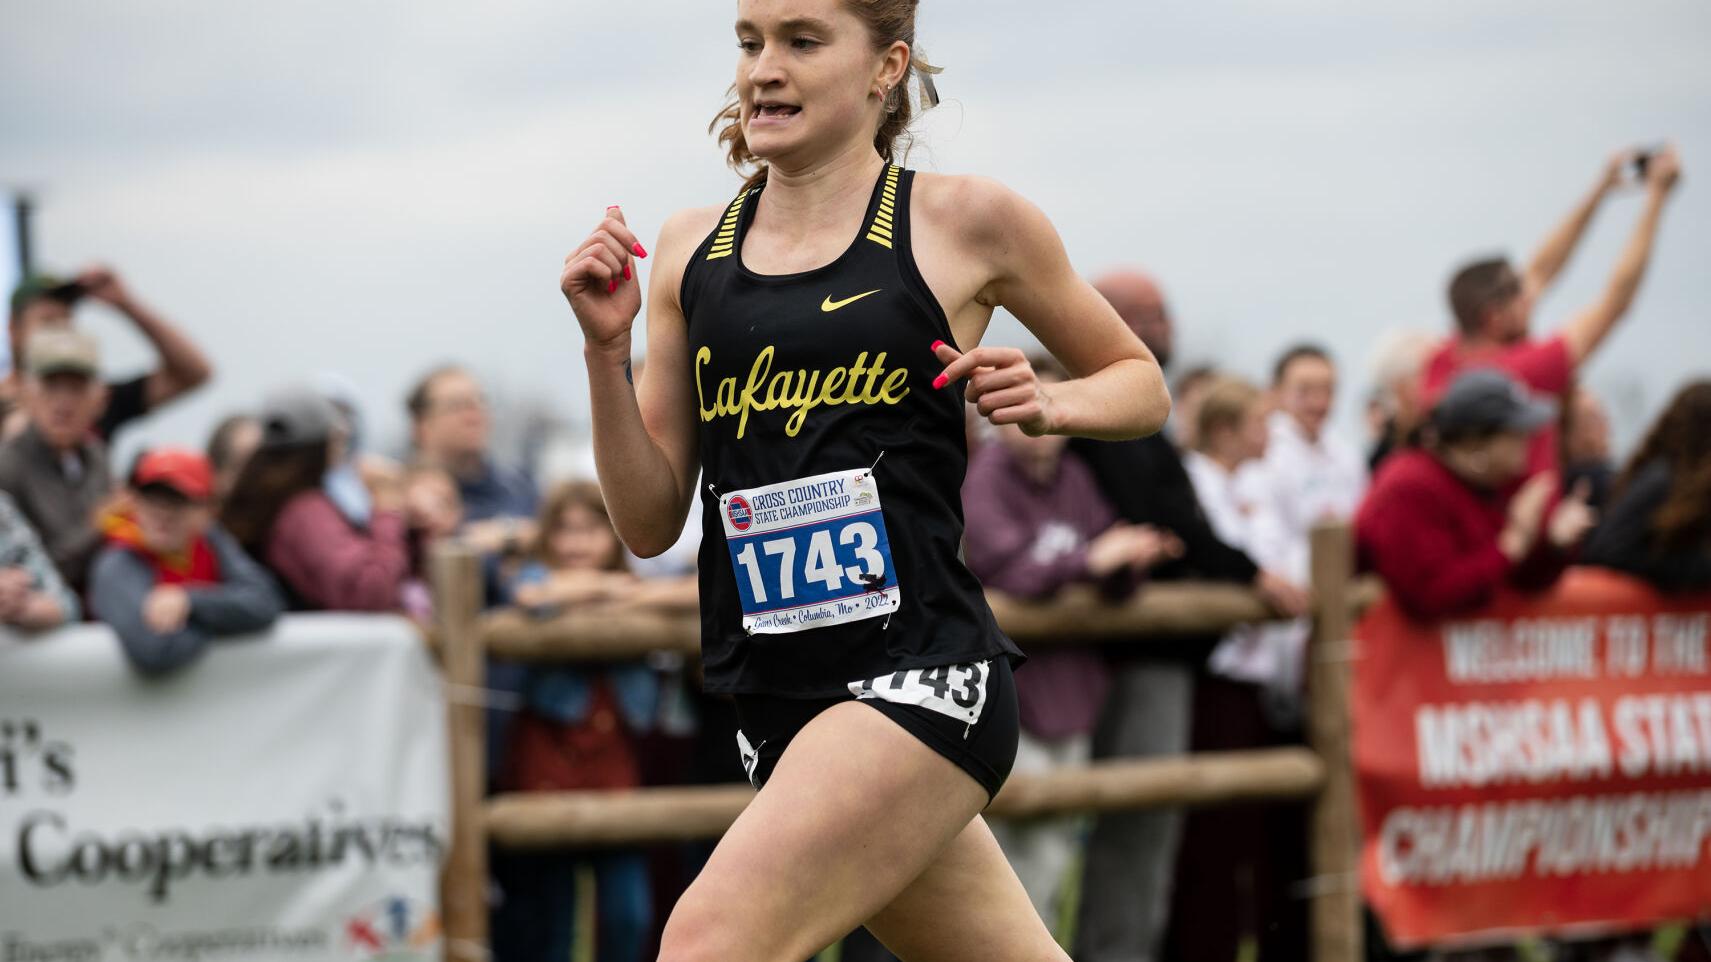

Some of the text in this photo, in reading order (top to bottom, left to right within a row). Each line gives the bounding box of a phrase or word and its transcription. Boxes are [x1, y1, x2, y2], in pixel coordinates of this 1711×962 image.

[696, 345, 910, 439] Lafayette
[752, 491, 786, 511] CROSS
[787, 478, 845, 504] COUNTRY
[754, 510, 779, 525] STATE
[780, 495, 851, 520] CHAMPIONSHIP
[737, 521, 885, 604] 1743
[798, 609, 835, 624] Columbia,
[835, 602, 853, 615] Mo
[865, 594, 889, 610] 2022
[1445, 611, 1709, 683] WELCOME TO THE
[861, 663, 983, 709] 43
[1416, 699, 1612, 785] MSHSAA
[17, 800, 443, 903] Cooperatives
